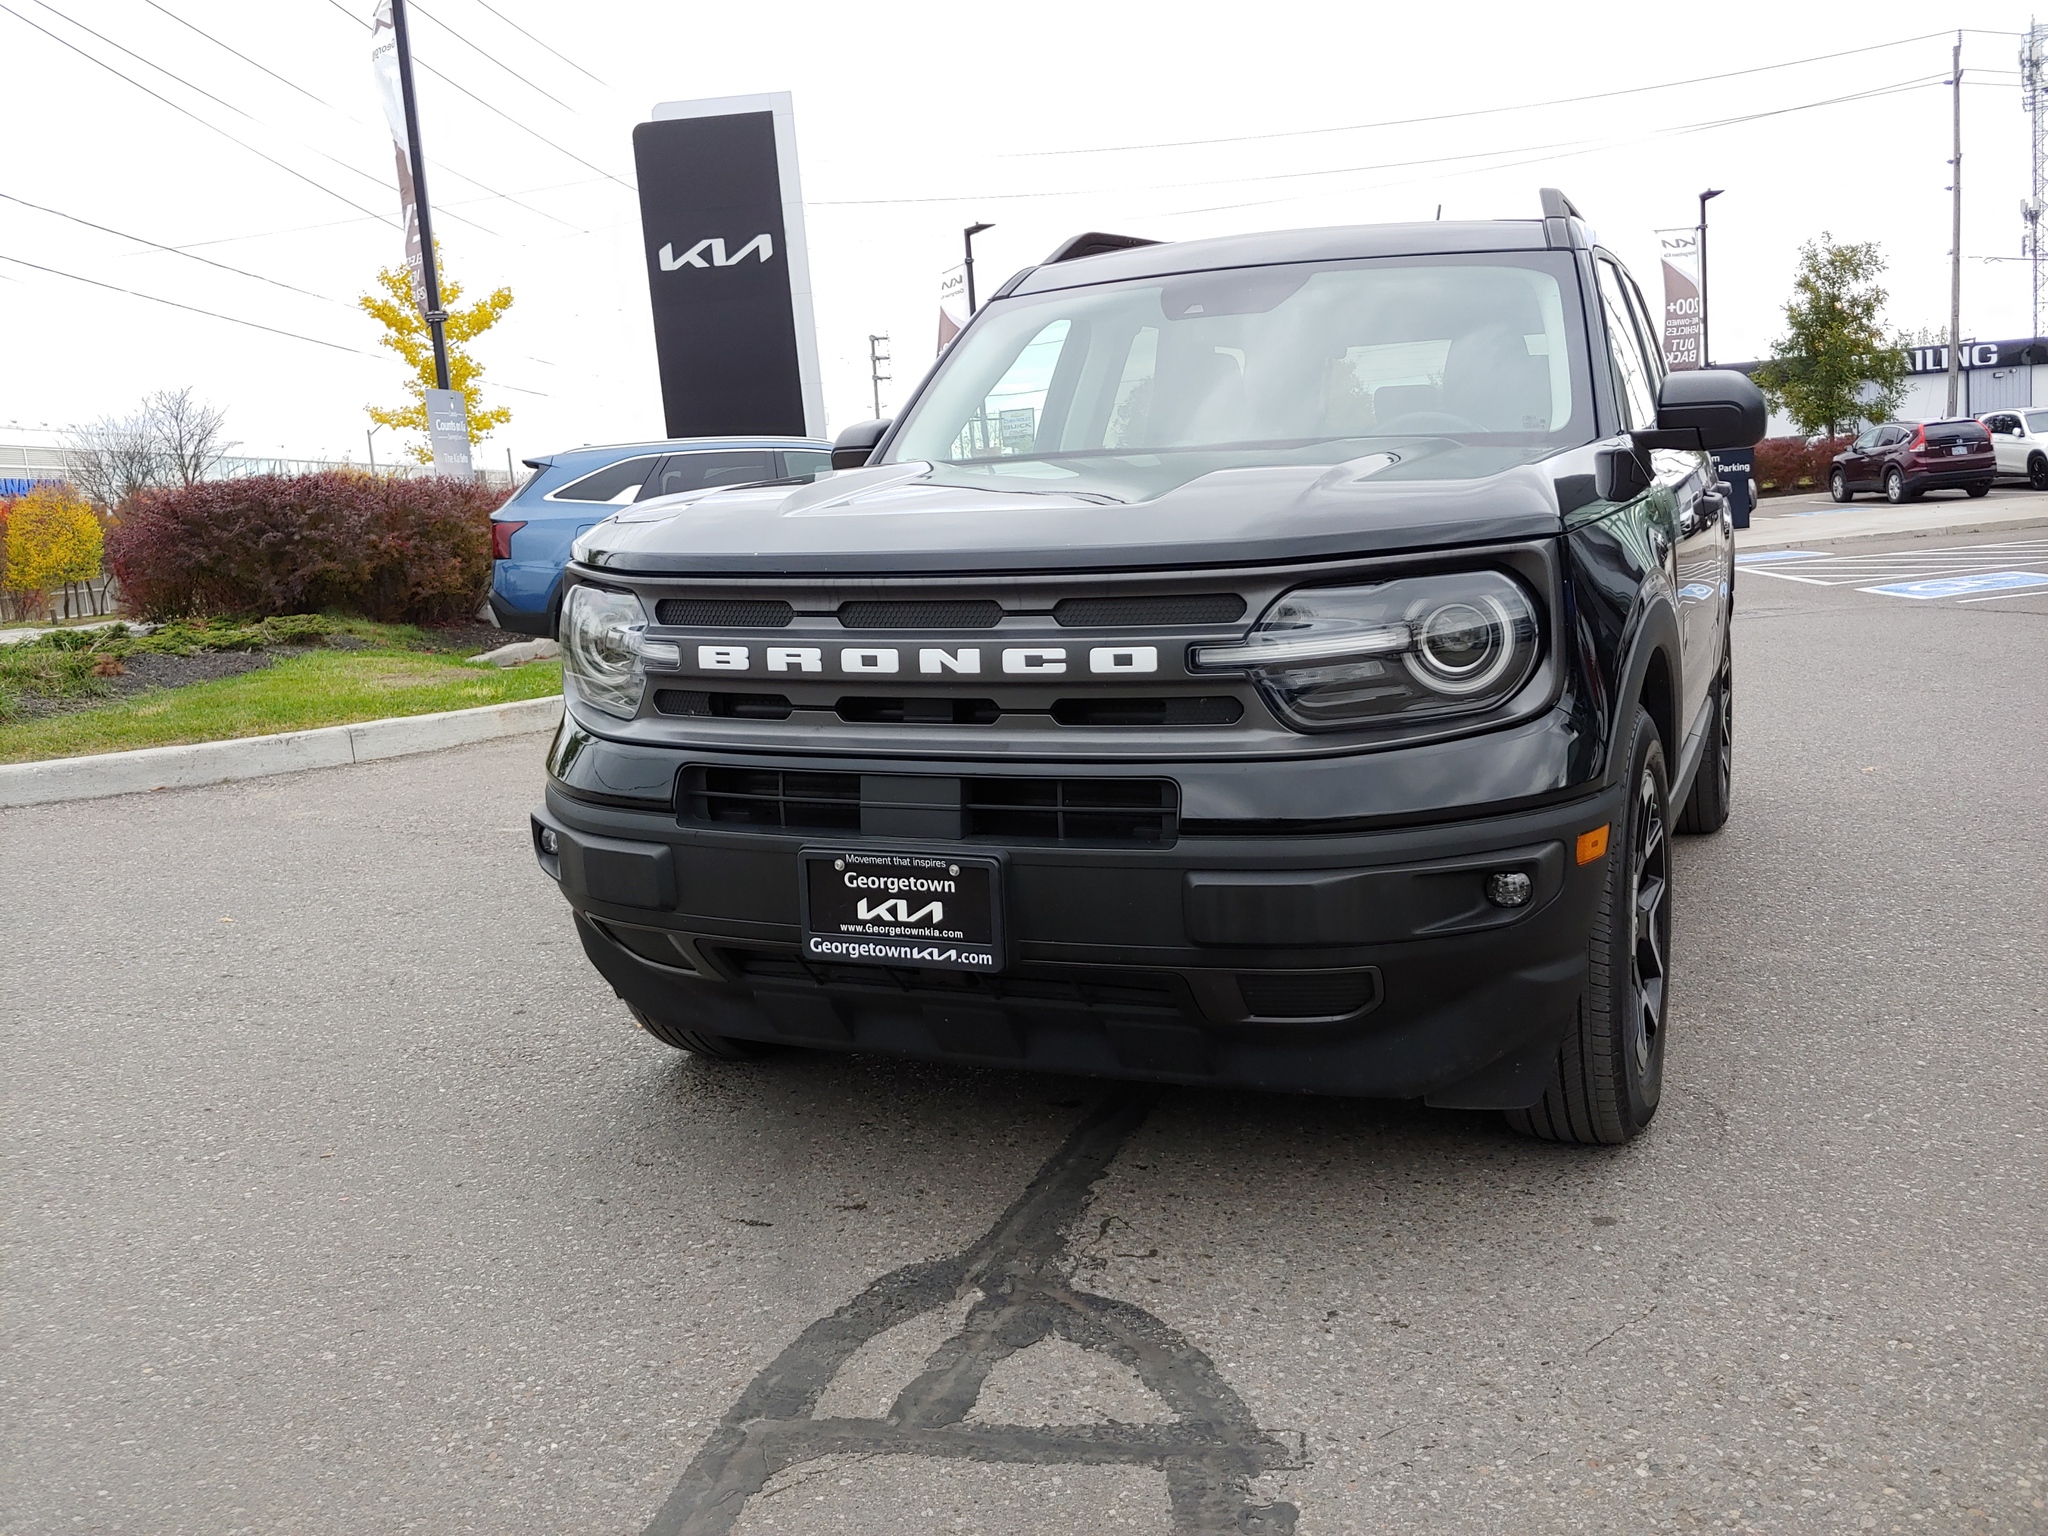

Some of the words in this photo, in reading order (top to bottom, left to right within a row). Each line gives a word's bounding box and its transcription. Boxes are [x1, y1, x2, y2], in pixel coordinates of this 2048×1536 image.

[658, 233, 774, 272] KIA
[1718, 463, 1750, 472] Parking
[697, 645, 1159, 675] BRONCO
[845, 854, 892, 865] Movement
[893, 856, 911, 866] that
[913, 857, 946, 868] inspires
[844, 872, 956, 893] Georgetown
[857, 897, 943, 924] KIA
[840, 923, 963, 938] www.Georgetownkia.com
